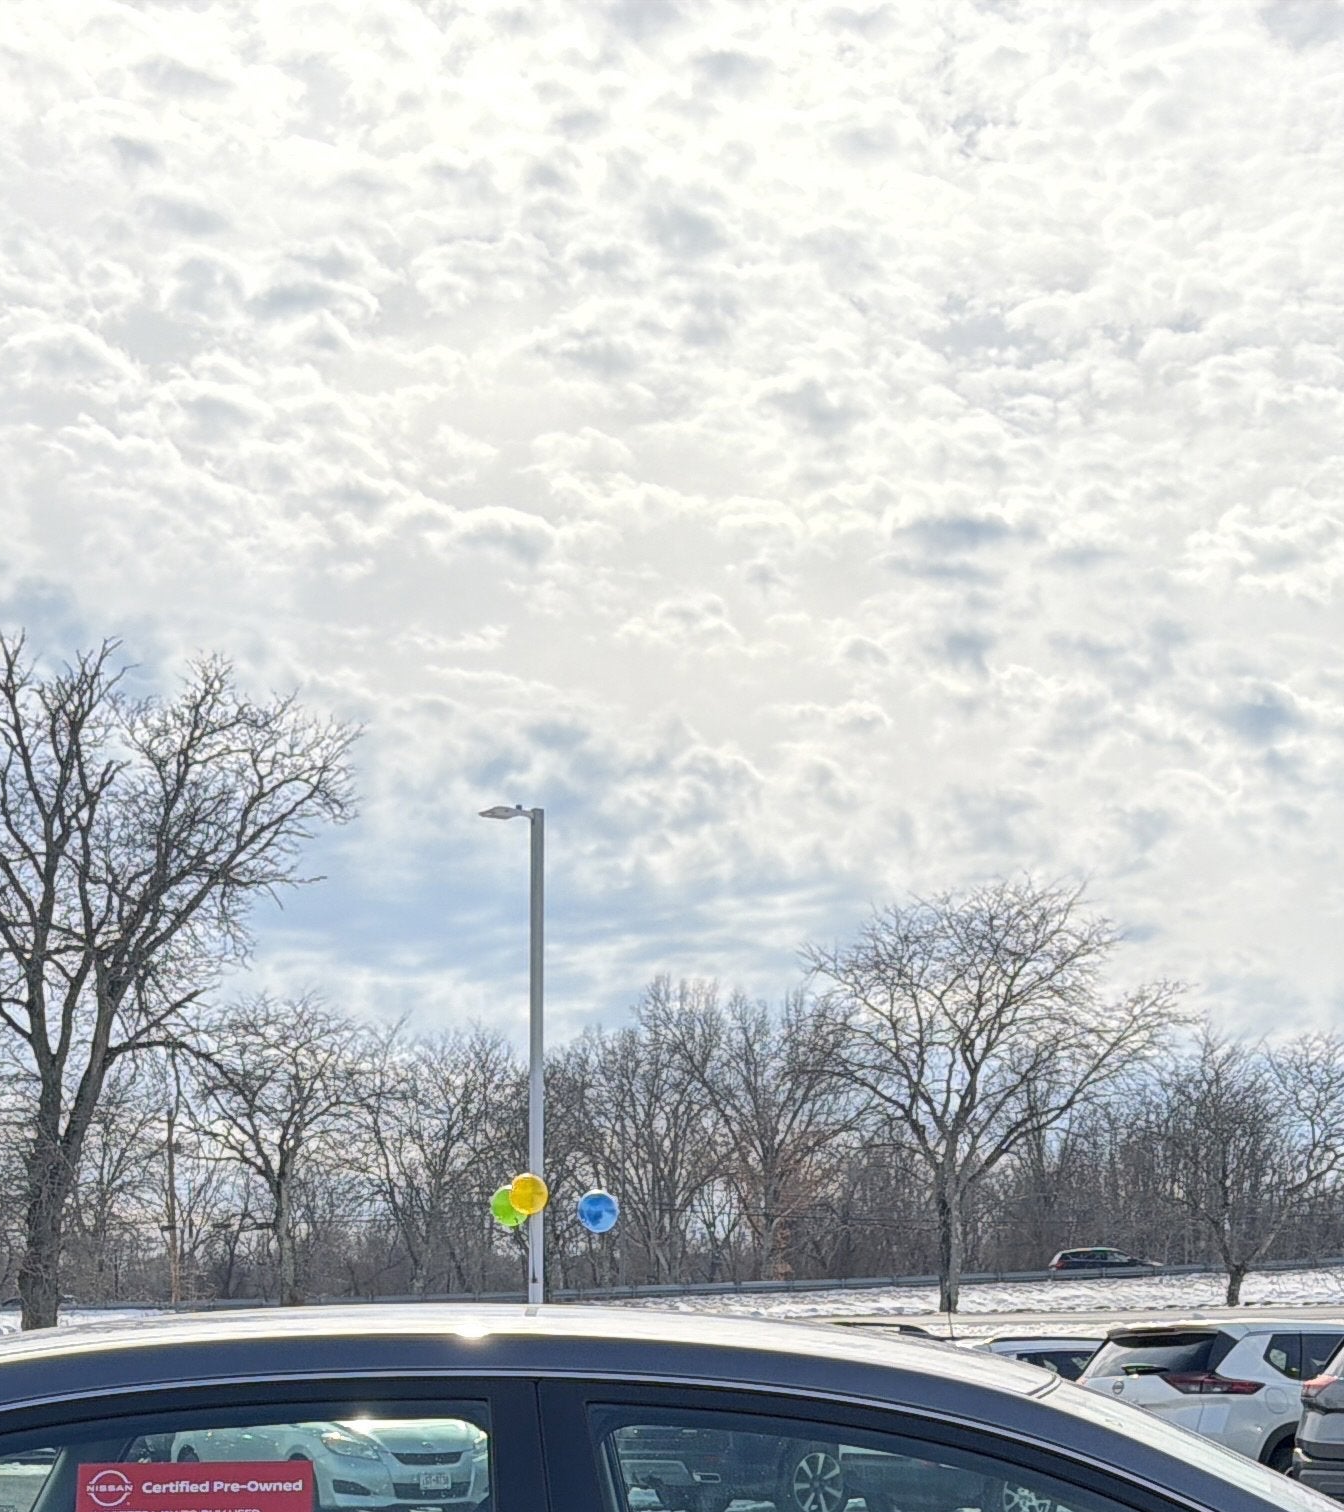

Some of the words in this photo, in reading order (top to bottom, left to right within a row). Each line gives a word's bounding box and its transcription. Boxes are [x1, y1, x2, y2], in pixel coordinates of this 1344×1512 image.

[86, 1484, 133, 1492] NISSAN
[141, 1480, 209, 1493] Certified
[213, 1479, 303, 1492] Pre-Owned
